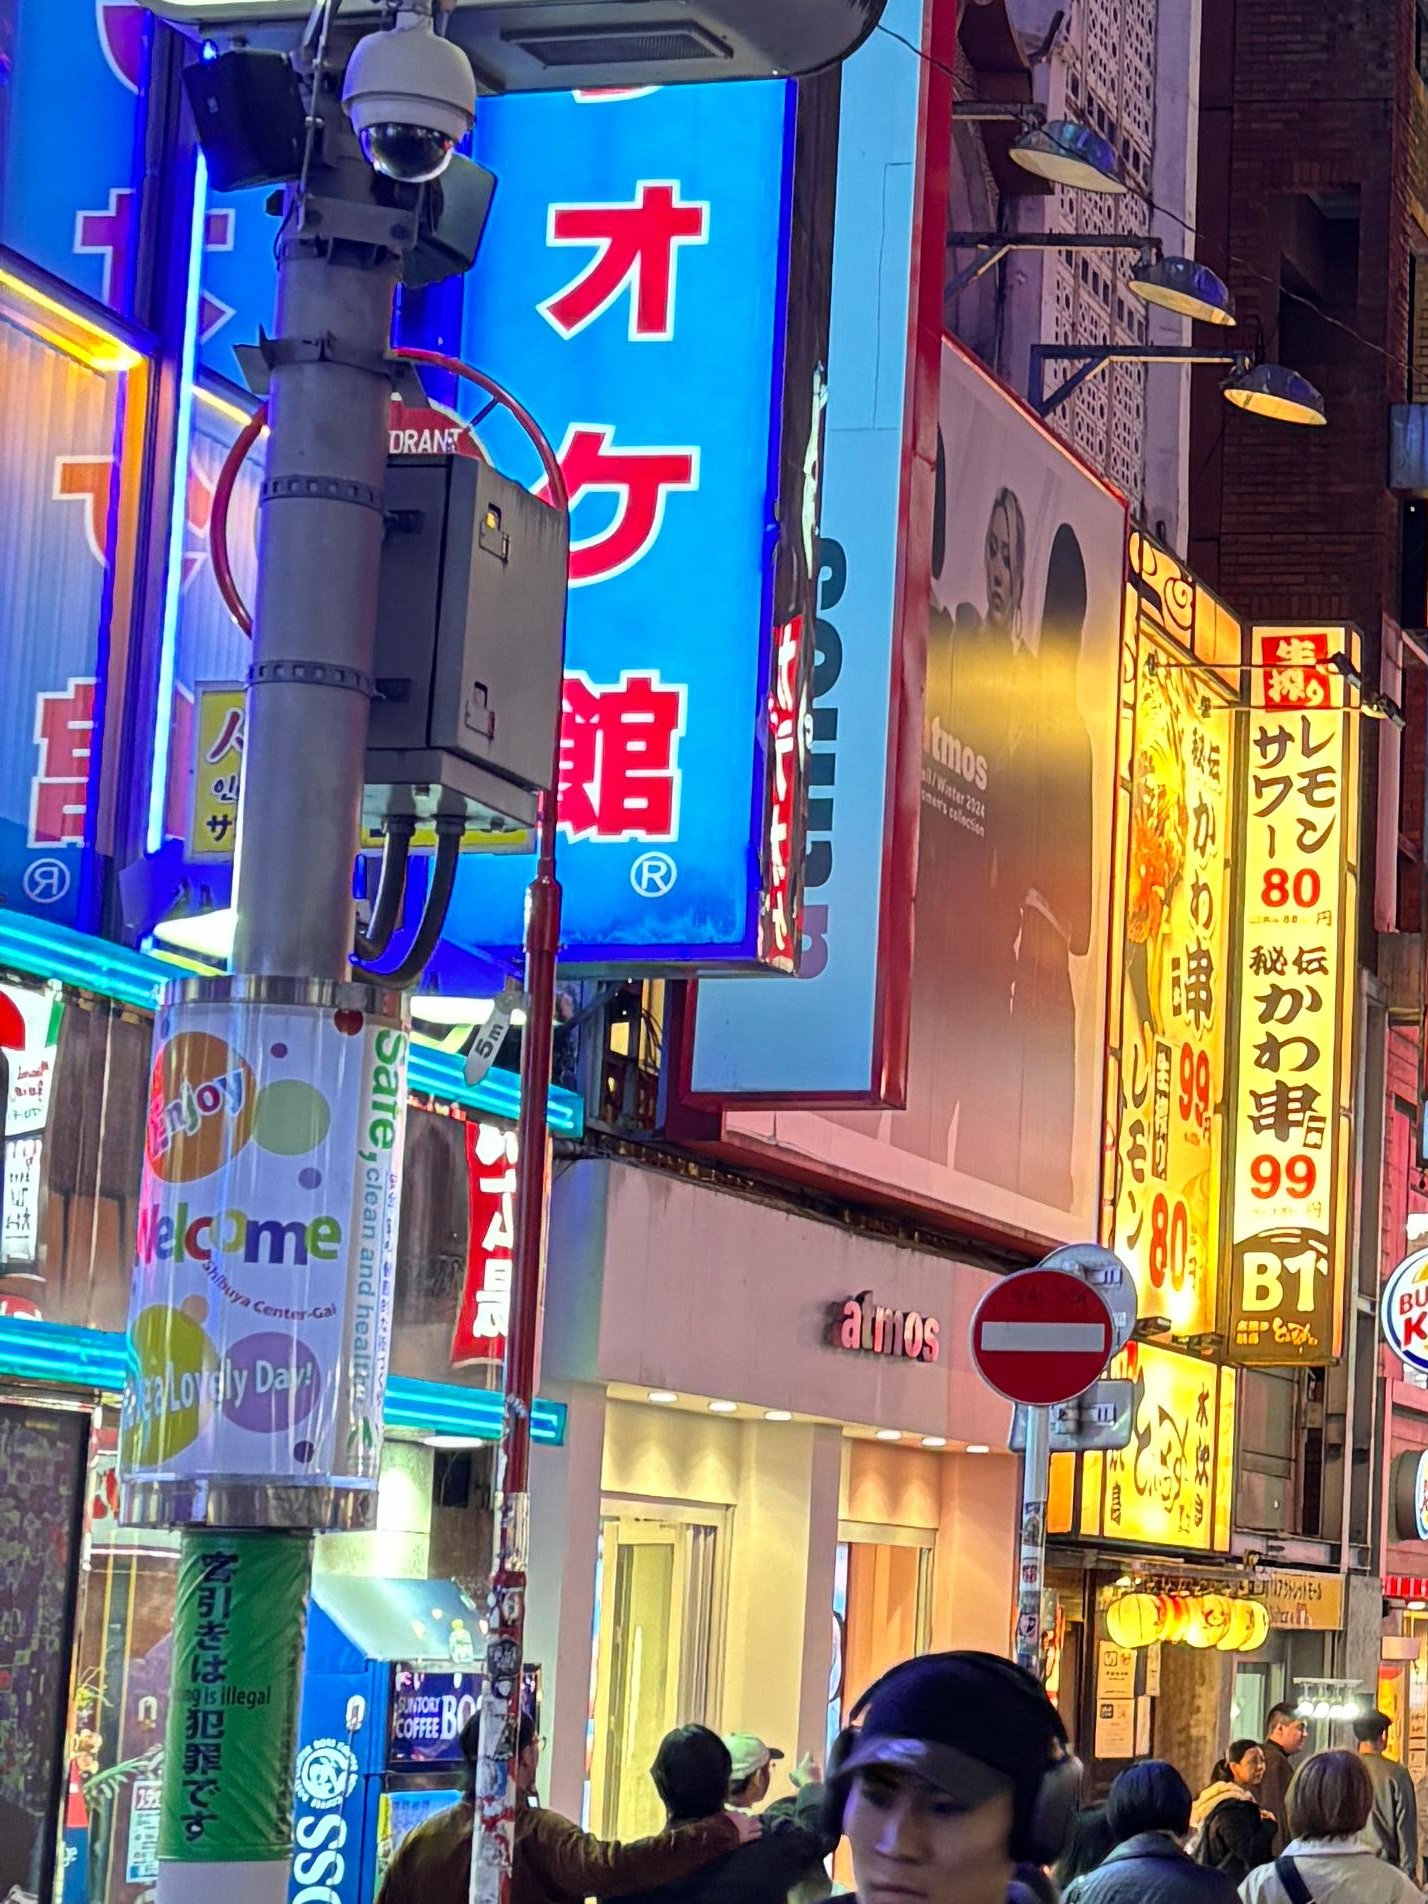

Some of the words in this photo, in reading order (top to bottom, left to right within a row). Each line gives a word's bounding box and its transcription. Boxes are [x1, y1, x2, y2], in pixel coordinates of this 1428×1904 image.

[388, 428, 462, 454] DRANT
[1252, 723, 1295, 858] サワー
[1296, 714, 1337, 856] レモン
[1261, 867, 1321, 909] 80
[1249, 944, 1330, 977] 秘伝
[476, 1023, 504, 1059] 5m
[1247, 982, 1324, 1144] かわ串
[150, 1066, 245, 1160] Enjoy
[1178, 1042, 1211, 1130] 99
[1249, 1153, 1317, 1200] 99
[137, 1201, 342, 1267] Welcome
[1149, 1192, 1188, 1293] 80
[840, 1296, 941, 1363] atmos
[182, 1550, 238, 1843] 客引きは犯罪です
[219, 1684, 271, 1708] illegal
[395, 1716, 440, 1740] COFFEE
[440, 1693, 484, 1740] BO
